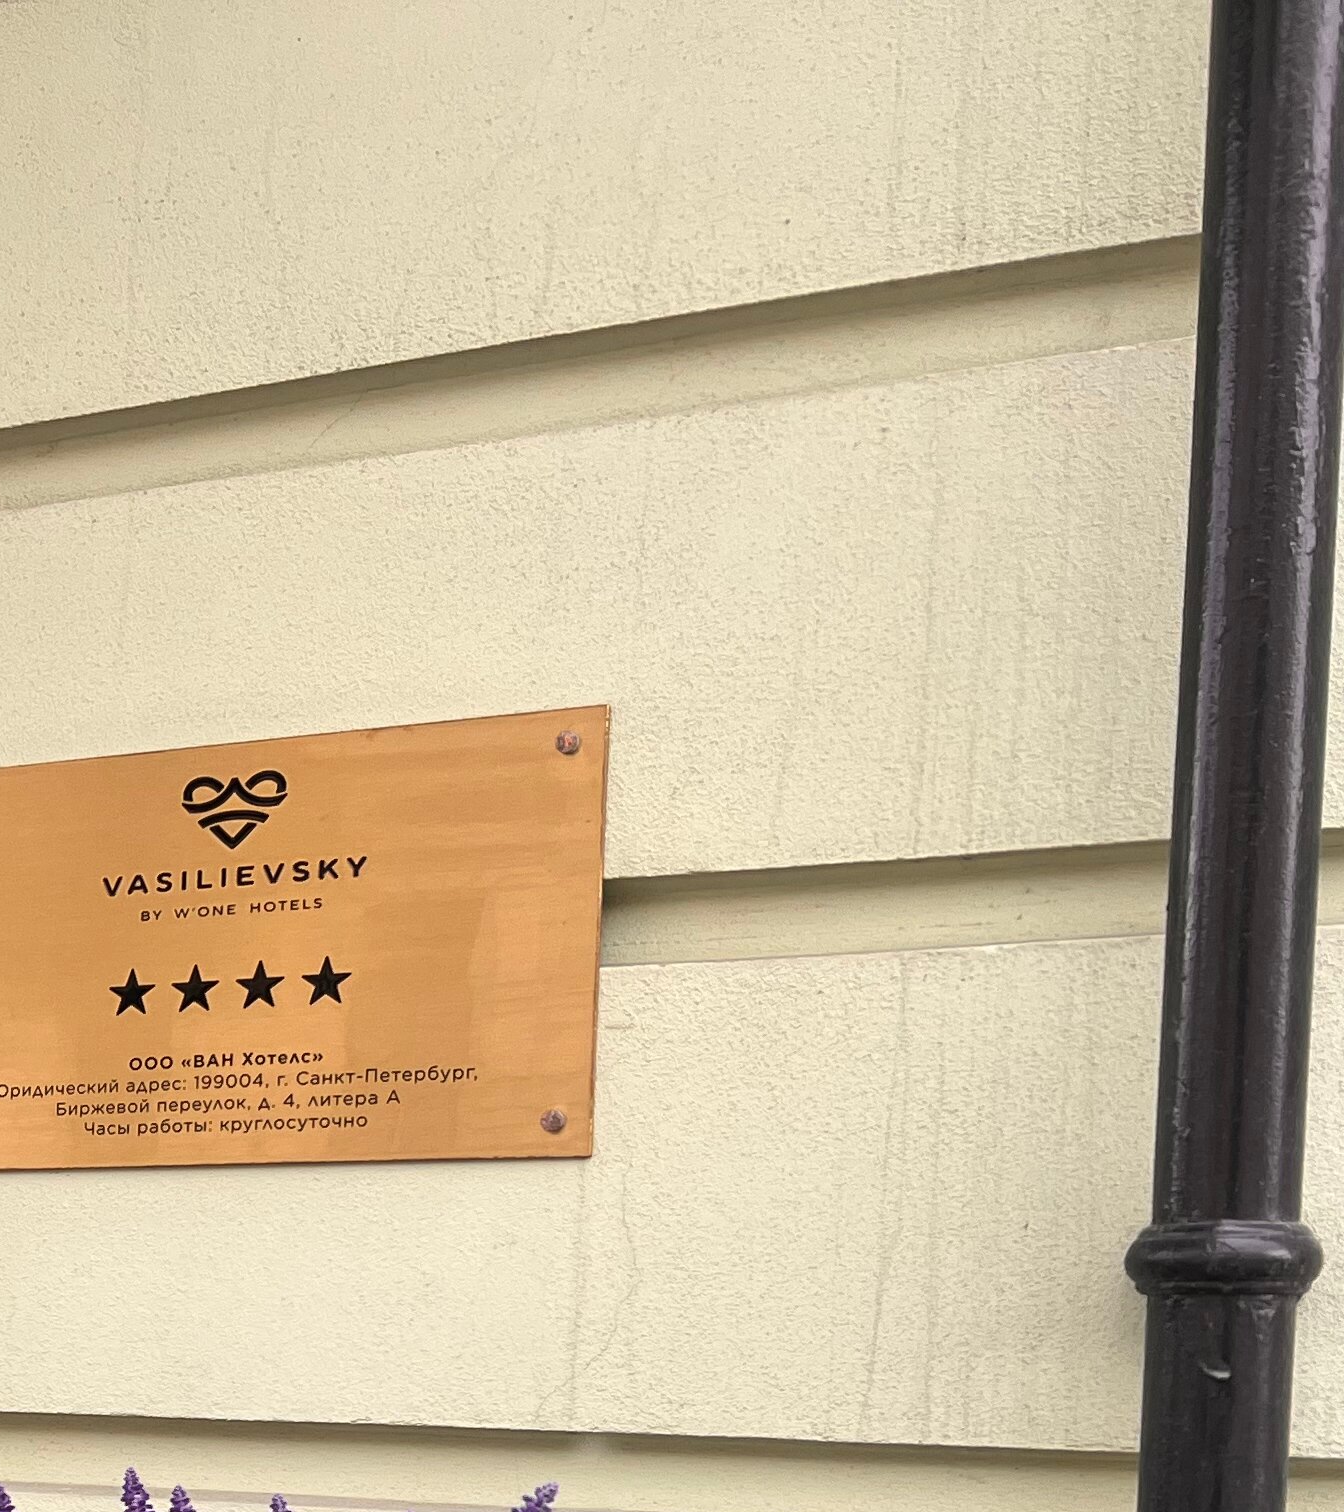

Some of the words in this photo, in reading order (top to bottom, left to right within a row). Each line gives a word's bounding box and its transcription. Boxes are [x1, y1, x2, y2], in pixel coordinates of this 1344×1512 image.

[102, 856, 368, 897] VASILIEVSKY
[140, 909, 163, 922] BY
[249, 897, 324, 914] HOTELS
[128, 1056, 174, 1071] ООО
[181, 1053, 235, 1069] «ВАН
[241, 1052, 325, 1067] Хотелс»
[125, 1078, 188, 1096] адрес:
[193, 1072, 270, 1089] 199004,
[276, 1074, 290, 1087] г.
[296, 1064, 479, 1086] Санкт-Петербург,
[55, 1098, 150, 1118] Биржевой
[156, 1097, 252, 1115] переулок,
[257, 1097, 276, 1112] д.
[283, 1093, 301, 1110] 4,
[307, 1091, 379, 1109] литера
[385, 1089, 402, 1105] А
[83, 1121, 131, 1136] Часы
[137, 1118, 214, 1137] работы:
[219, 1114, 369, 1135] круглосуточно
